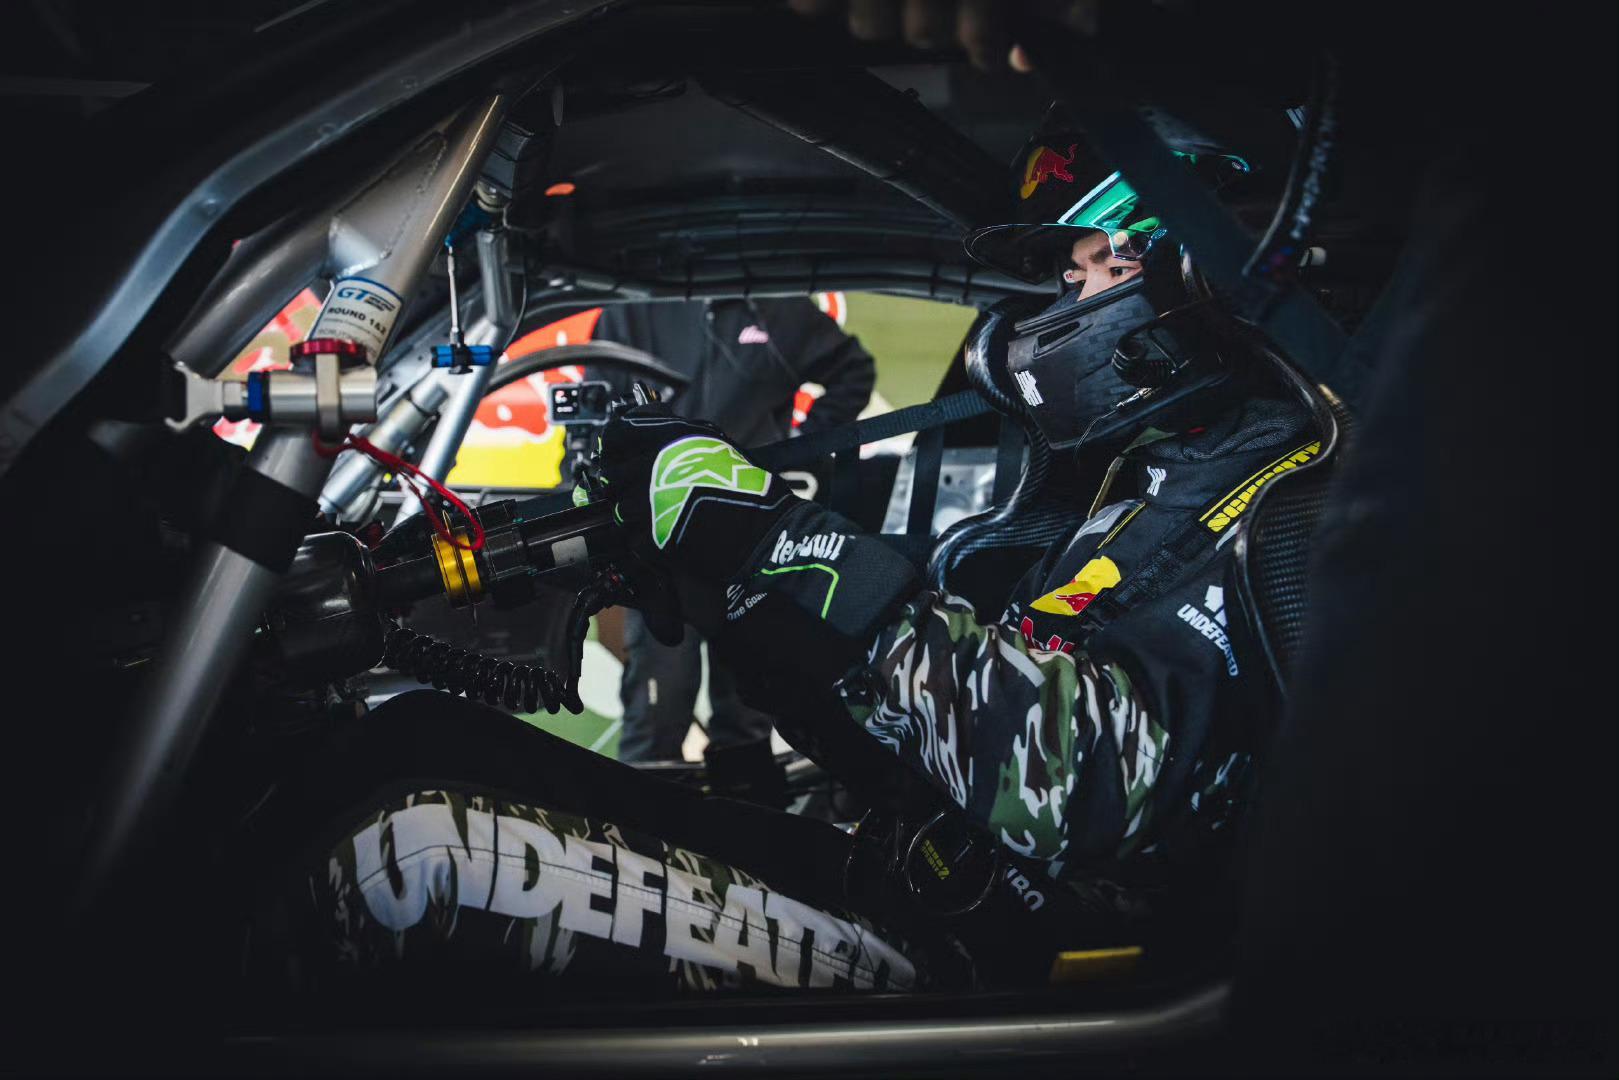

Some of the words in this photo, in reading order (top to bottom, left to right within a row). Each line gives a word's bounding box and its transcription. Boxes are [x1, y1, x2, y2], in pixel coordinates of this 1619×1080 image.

[337, 287, 368, 300] GT
[328, 307, 366, 321] ROUND
[369, 318, 387, 335] 1&2
[727, 605, 746, 621] One
[1176, 603, 1239, 676] UNDEFEATED
